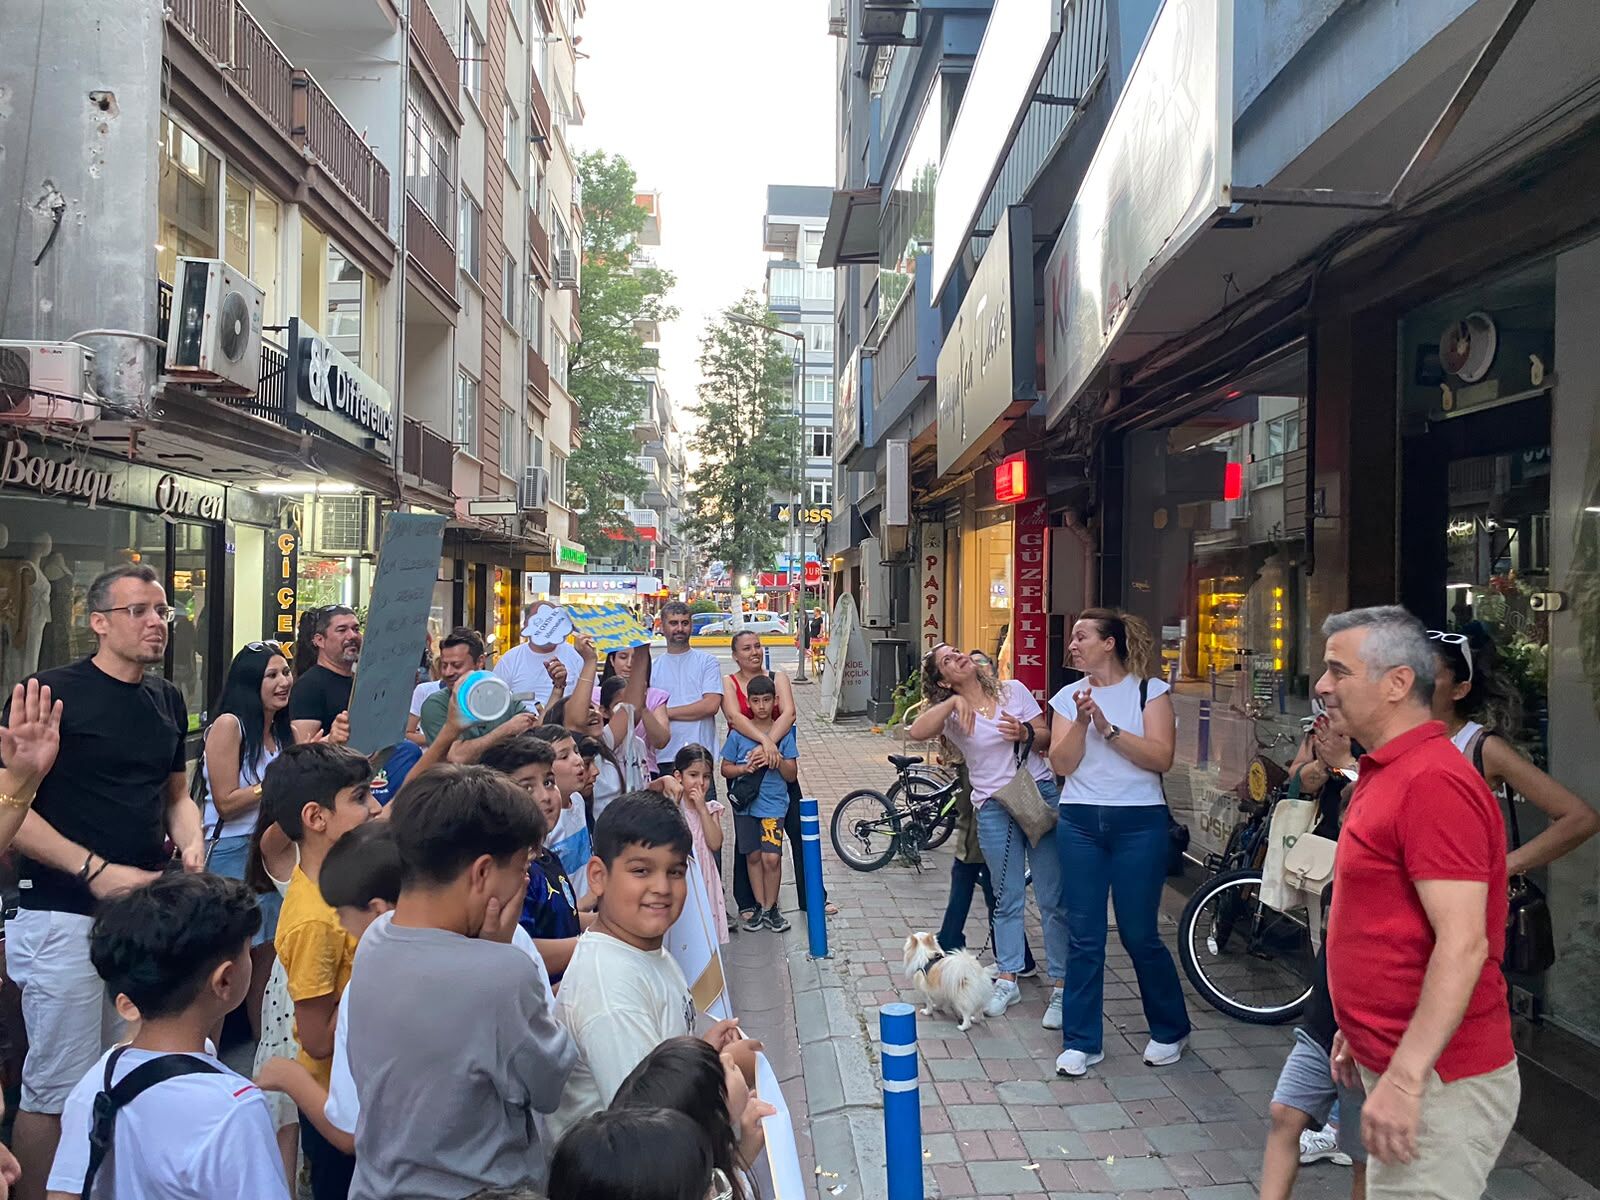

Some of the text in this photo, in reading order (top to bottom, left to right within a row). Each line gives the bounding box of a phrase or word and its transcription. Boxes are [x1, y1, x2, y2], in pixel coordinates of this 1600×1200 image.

[336, 364, 393, 442] Difference
[0, 438, 224, 524] Boutiqu Quen
[277, 533, 295, 659] ÇİÇEK
[924, 555, 939, 649] PAPAT
[1018, 533, 1043, 666] GÜZELLİK
[833, 660, 863, 669] OKİDE
